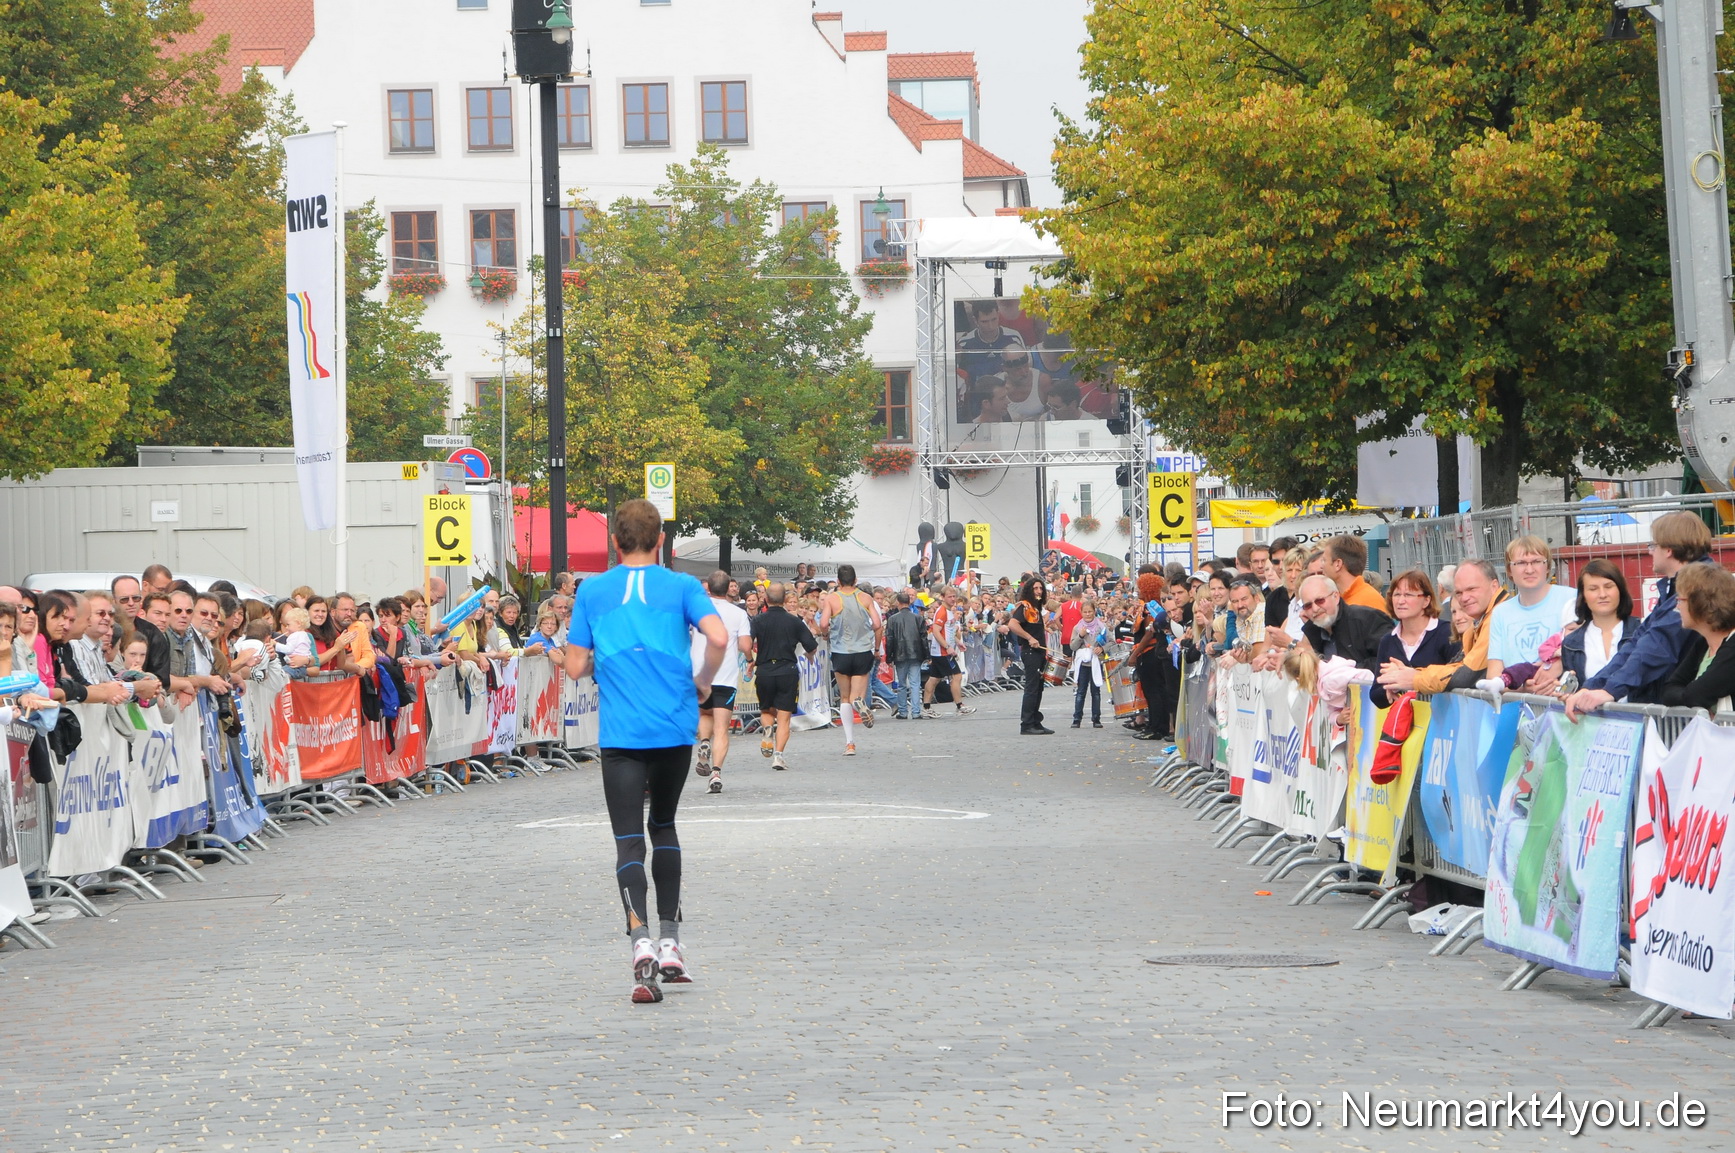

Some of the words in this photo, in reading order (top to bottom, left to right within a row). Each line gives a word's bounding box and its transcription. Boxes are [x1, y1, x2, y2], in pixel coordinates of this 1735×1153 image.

[426, 437, 444, 445] Ulmer
[445, 437, 464, 445] Gasse
[403, 466, 418, 477] WC
[654, 472, 666, 484] H
[1153, 475, 1190, 489] Block
[429, 497, 466, 510] Block
[1160, 493, 1184, 528] C
[435, 516, 460, 551] C
[972, 535, 984, 552] B
[1677, 930, 1714, 973] Radio
